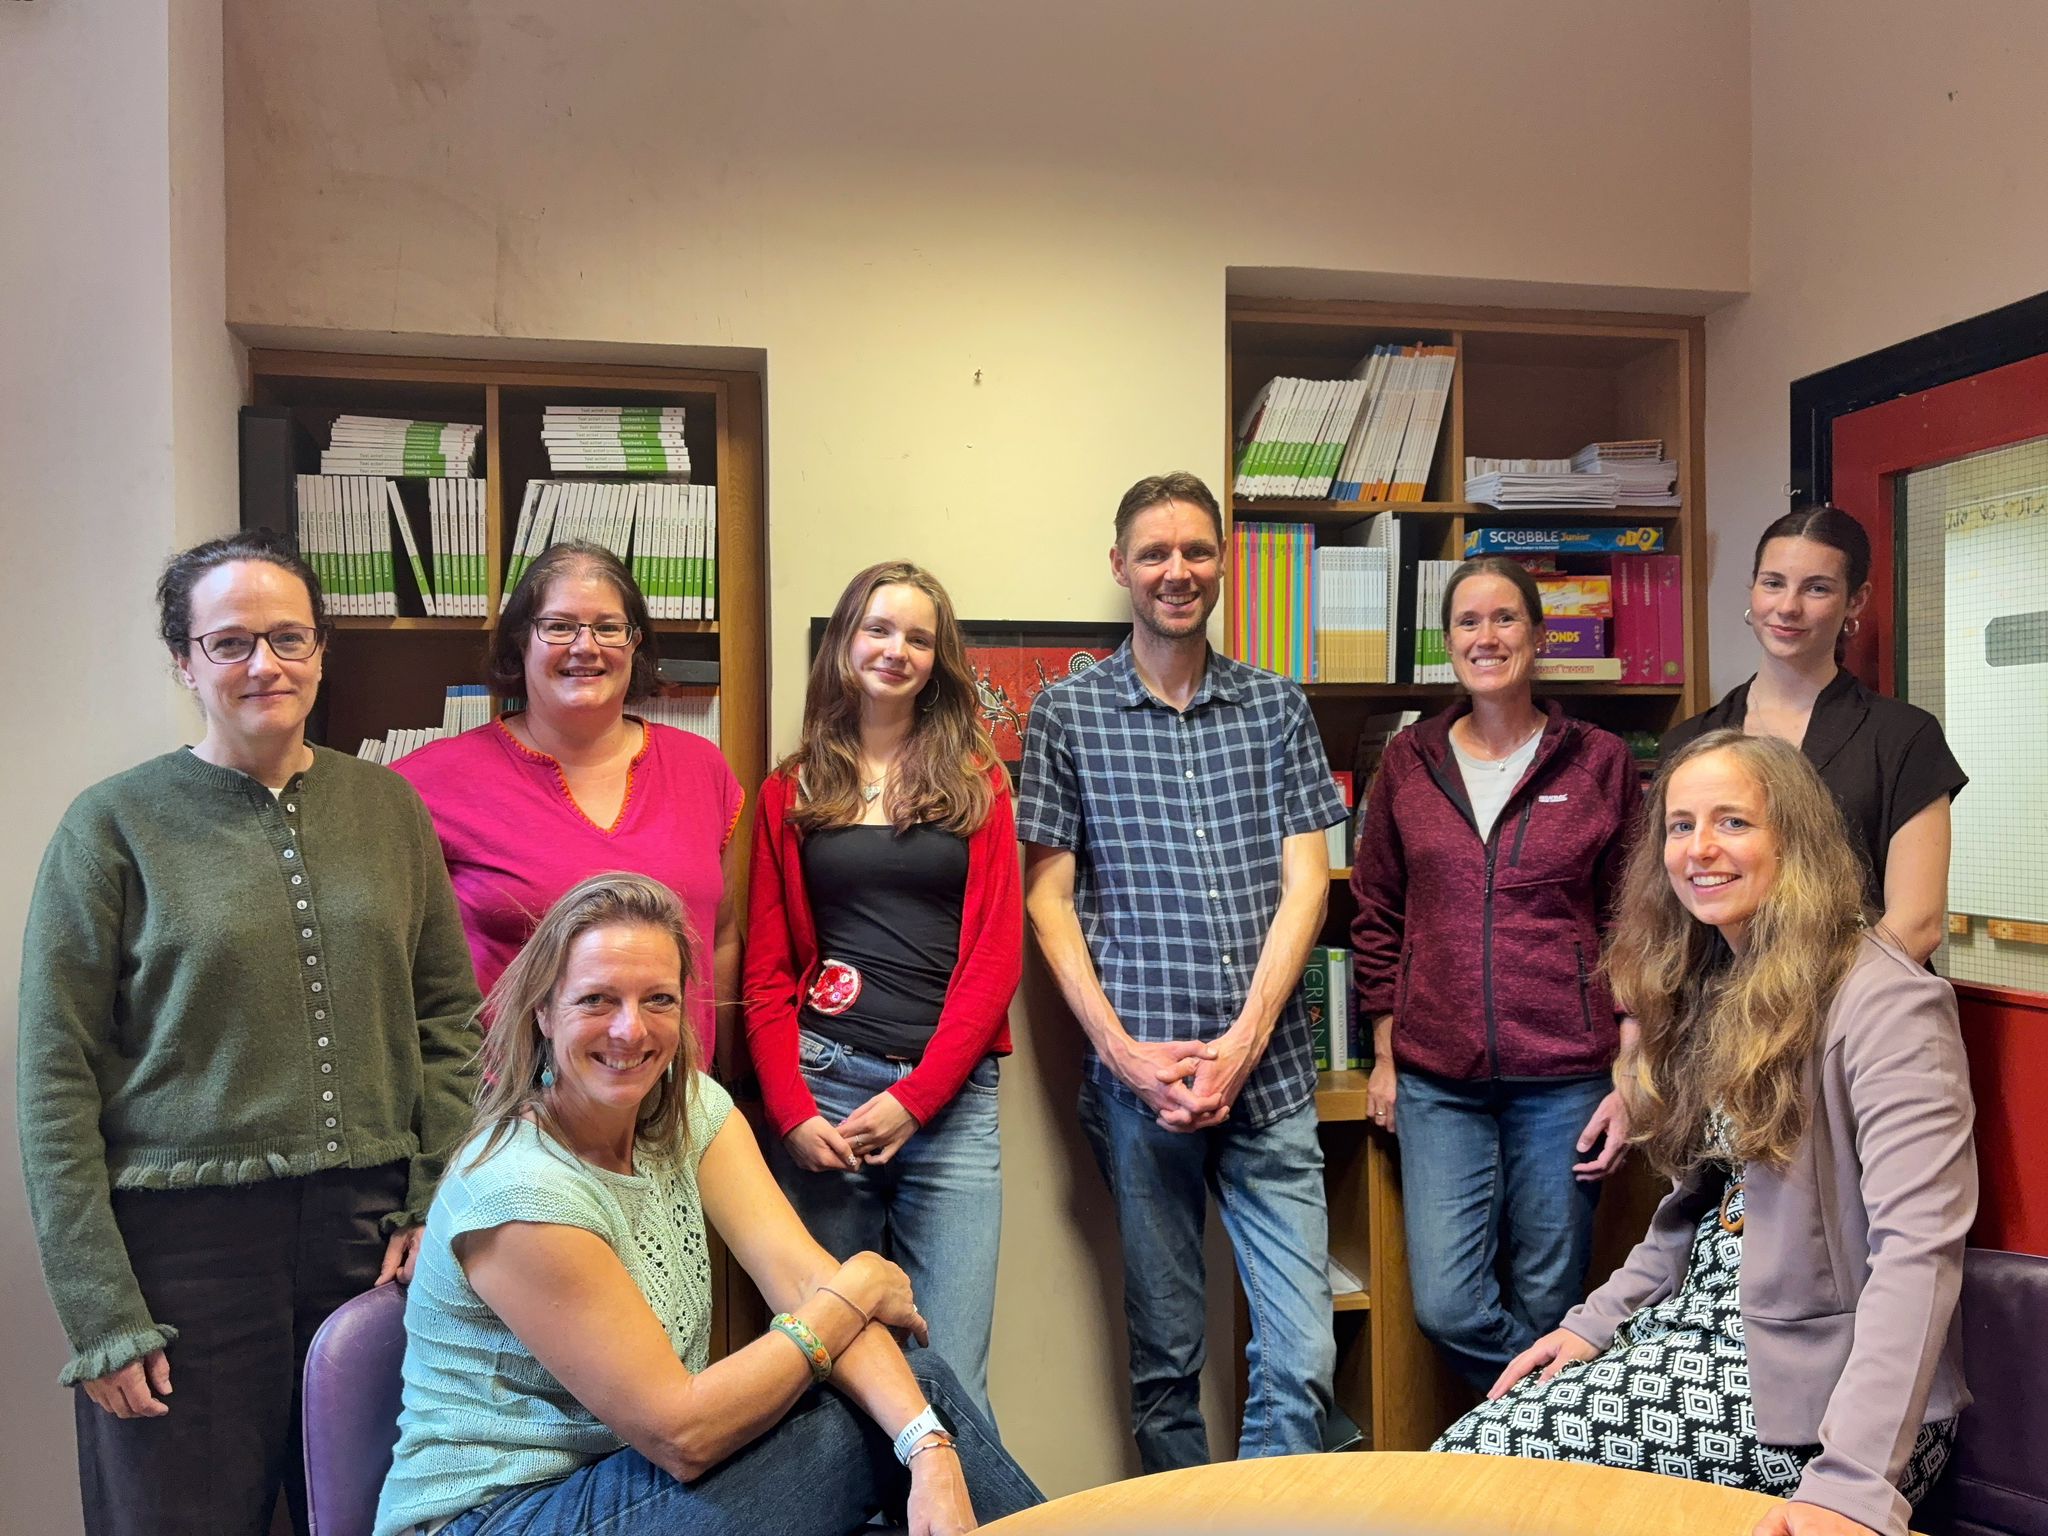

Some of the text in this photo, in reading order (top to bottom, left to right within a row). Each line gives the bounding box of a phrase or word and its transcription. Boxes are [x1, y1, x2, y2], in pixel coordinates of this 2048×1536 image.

[1489, 531, 1590, 545] SCRABBLE Junior
[1337, 1000, 1346, 1064] OORLOGSWINTER
